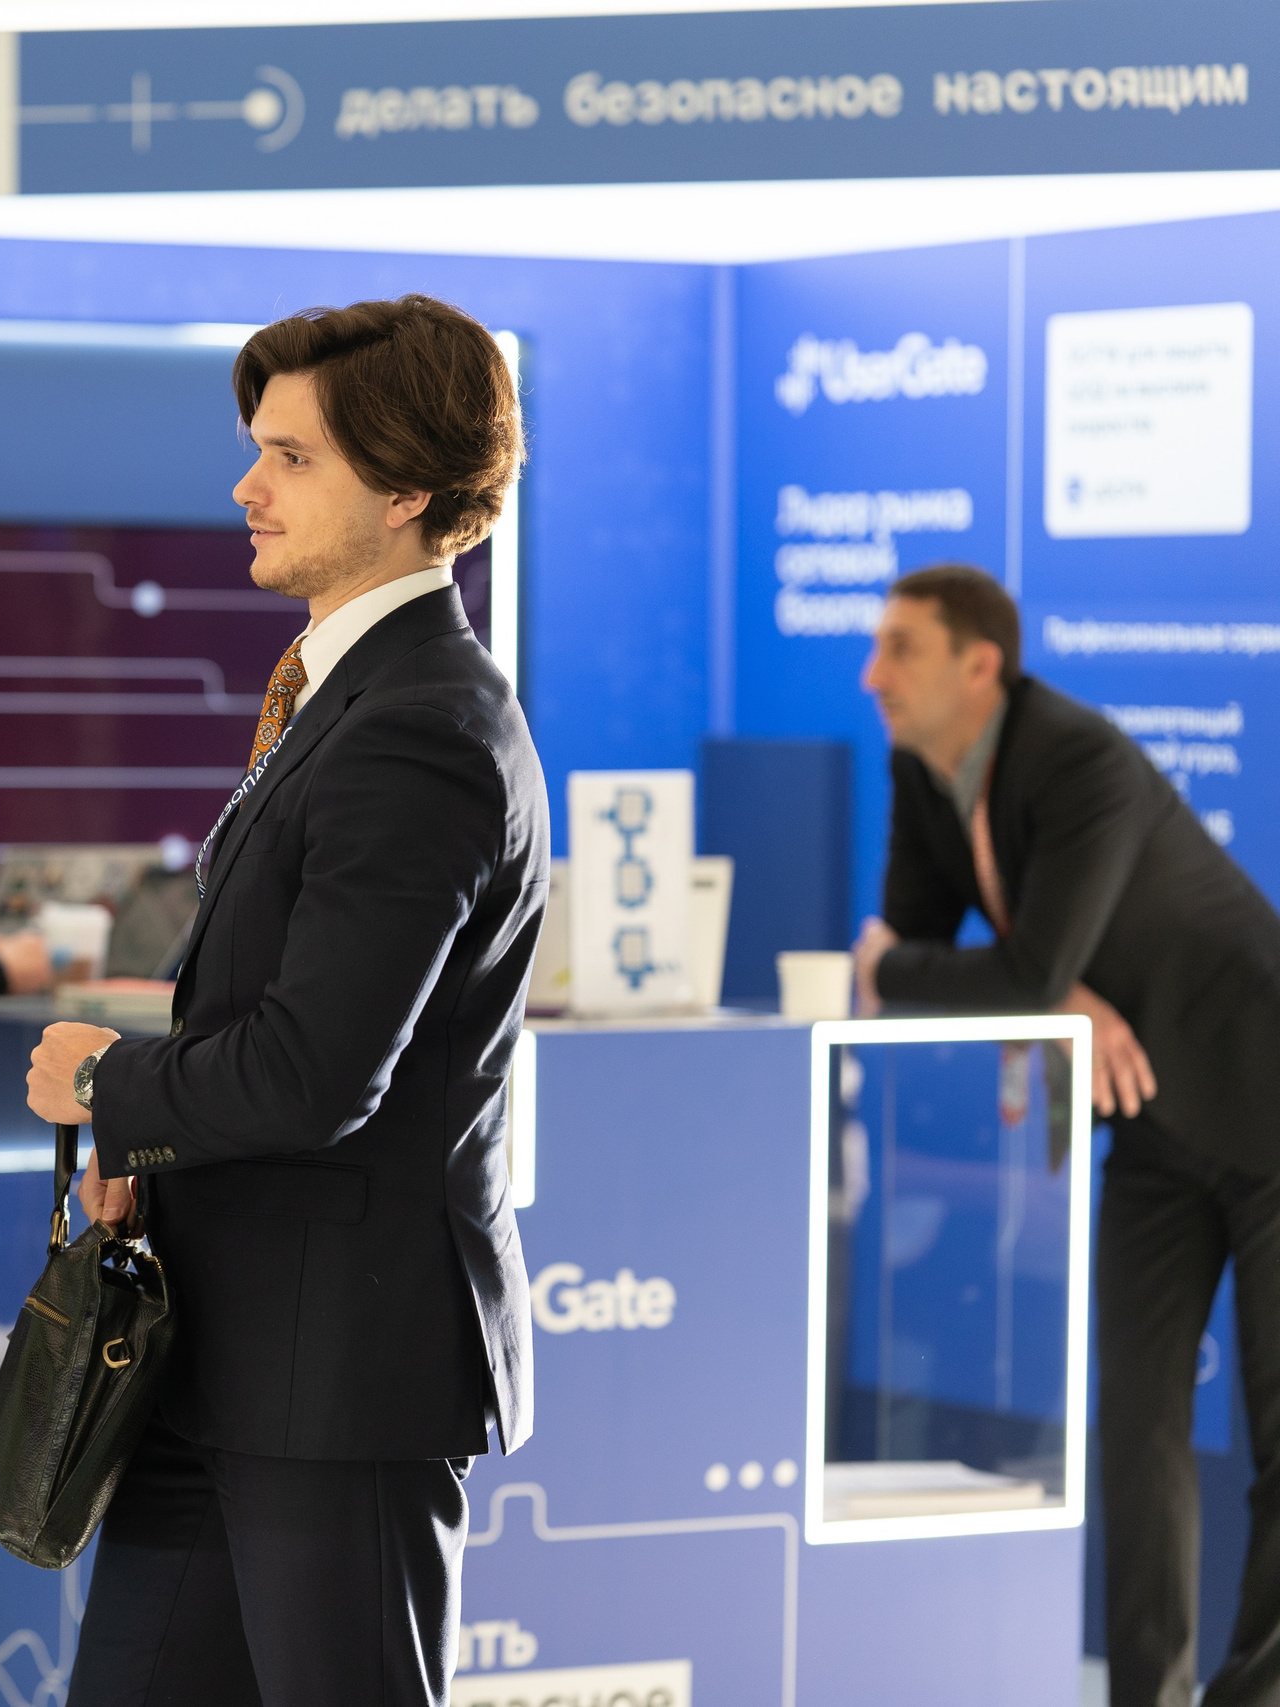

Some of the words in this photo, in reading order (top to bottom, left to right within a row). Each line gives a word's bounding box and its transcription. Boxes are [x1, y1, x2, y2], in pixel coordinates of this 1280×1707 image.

[335, 84, 539, 140] делать
[564, 71, 904, 128] безопасное
[932, 63, 1250, 115] настоящим
